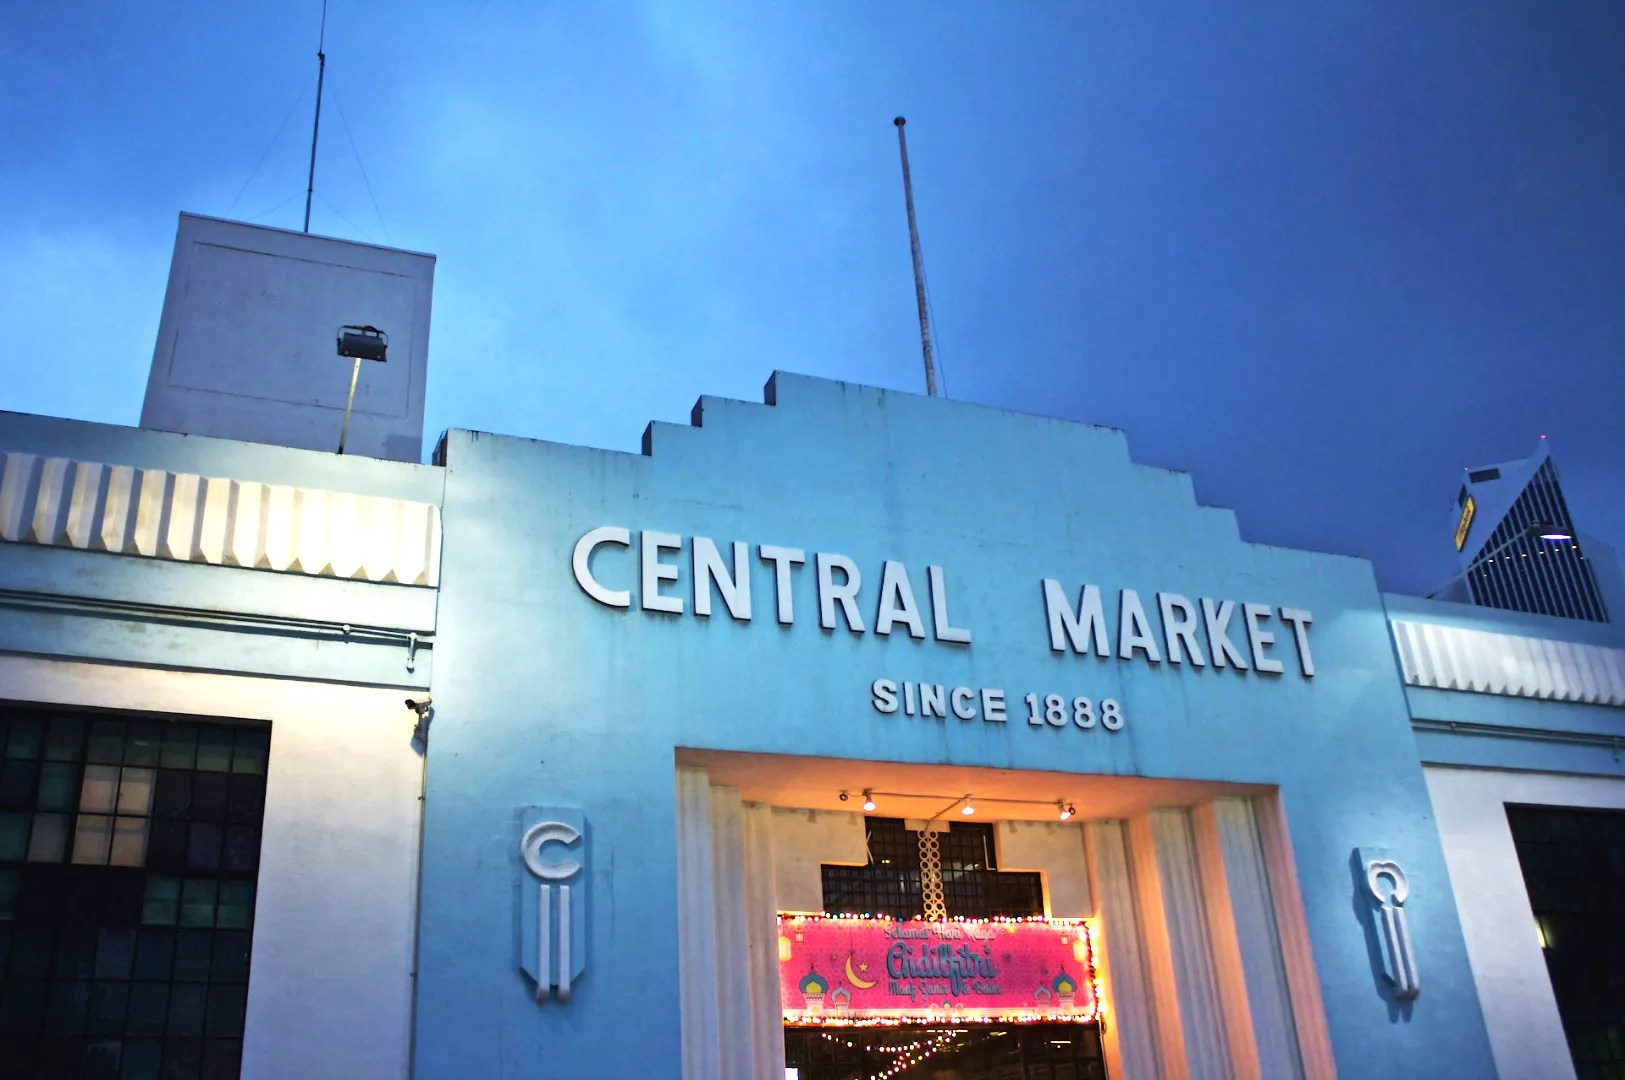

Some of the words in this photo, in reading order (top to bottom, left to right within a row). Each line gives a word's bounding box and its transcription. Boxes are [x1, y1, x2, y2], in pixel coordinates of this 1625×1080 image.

[571, 526, 972, 644] CENTRAL
[1041, 578, 1315, 677] MARKET
[871, 678, 1007, 723] SINCE
[1025, 692, 1125, 732] 1888
[884, 922, 929, 939] Selamat
[932, 921, 961, 940] Hari
[962, 922, 995, 948] Raya
[886, 941, 1000, 996] Aidilfitri
